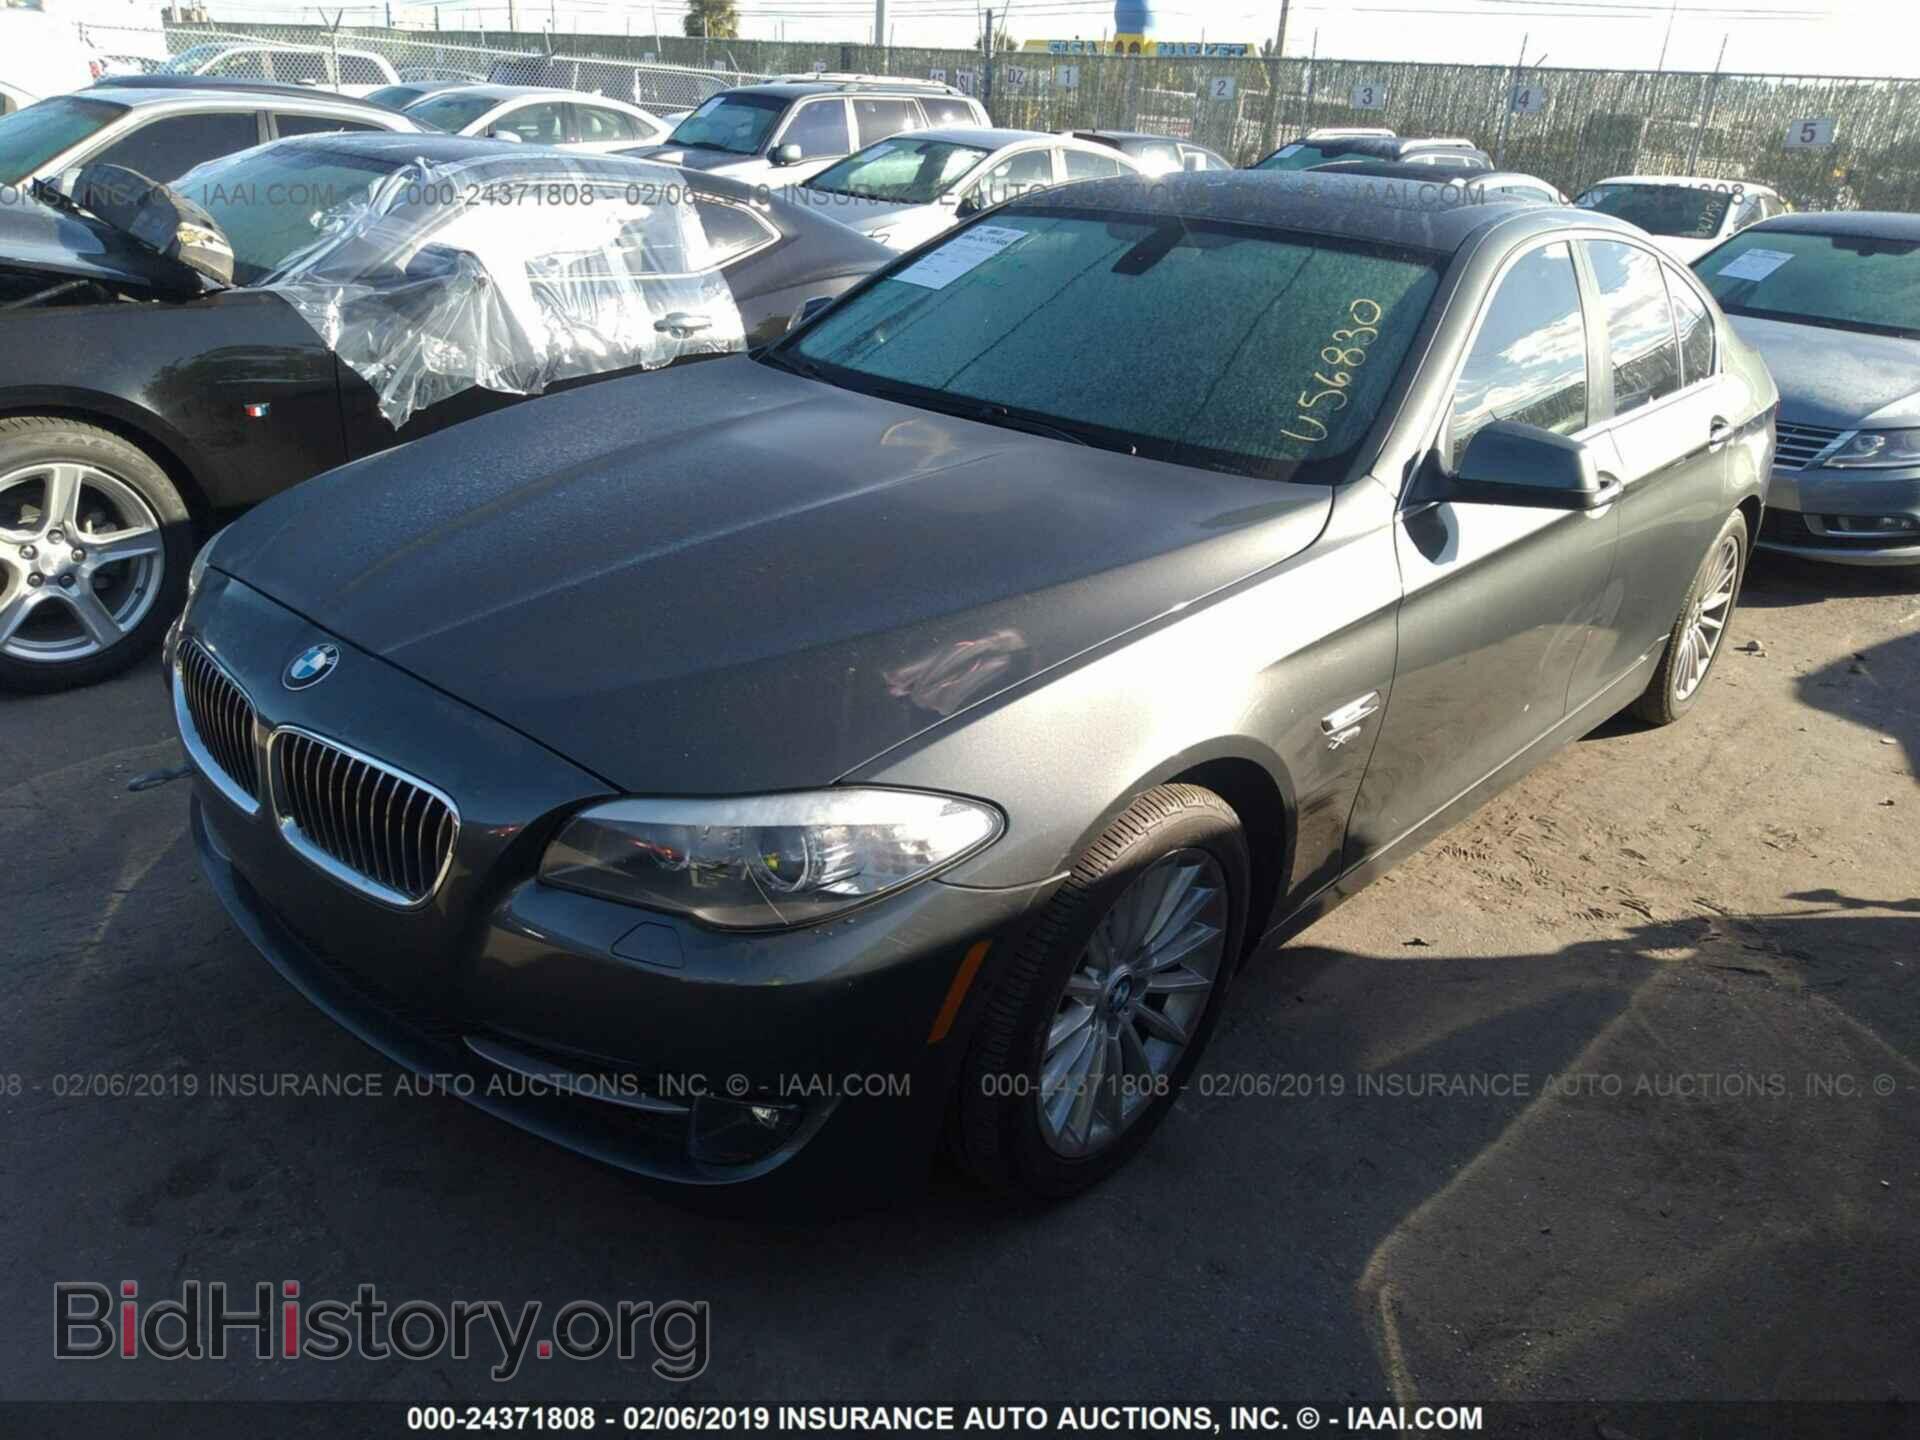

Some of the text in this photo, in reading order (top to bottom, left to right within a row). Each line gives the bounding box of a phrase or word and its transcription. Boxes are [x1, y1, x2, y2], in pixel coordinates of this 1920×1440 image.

[1063, 70, 1071, 84] 1
[1215, 80, 1227, 97] 2
[1362, 87, 1374, 105] 3
[1518, 89, 1530, 109] 4
[1800, 122, 1817, 144] 5
[1280, 298, 1382, 442] U56830
